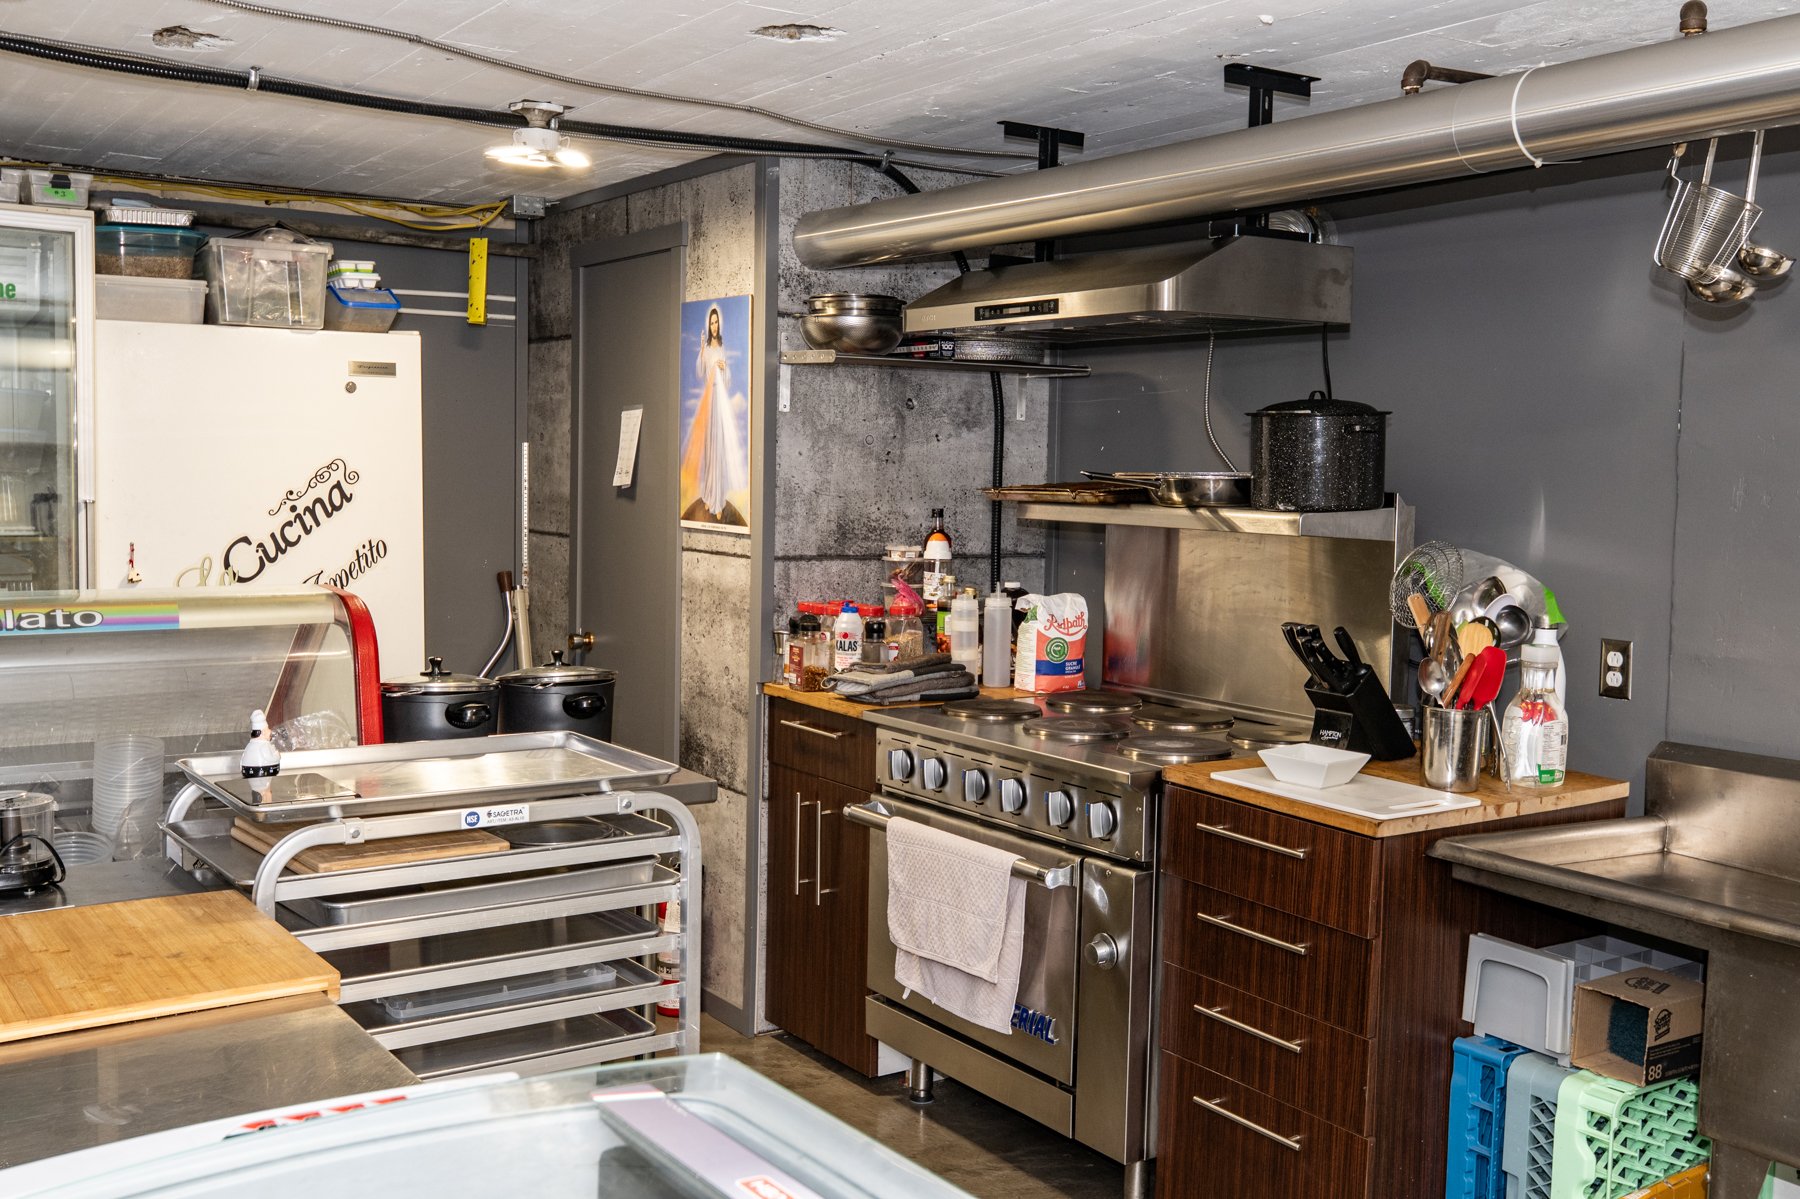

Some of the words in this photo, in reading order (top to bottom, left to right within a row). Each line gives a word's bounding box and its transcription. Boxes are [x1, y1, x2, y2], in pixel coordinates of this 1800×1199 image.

[223, 480, 353, 583] Cucina
[836, 640, 858, 652] KALAS
[1648, 1063, 1662, 1081] 88
